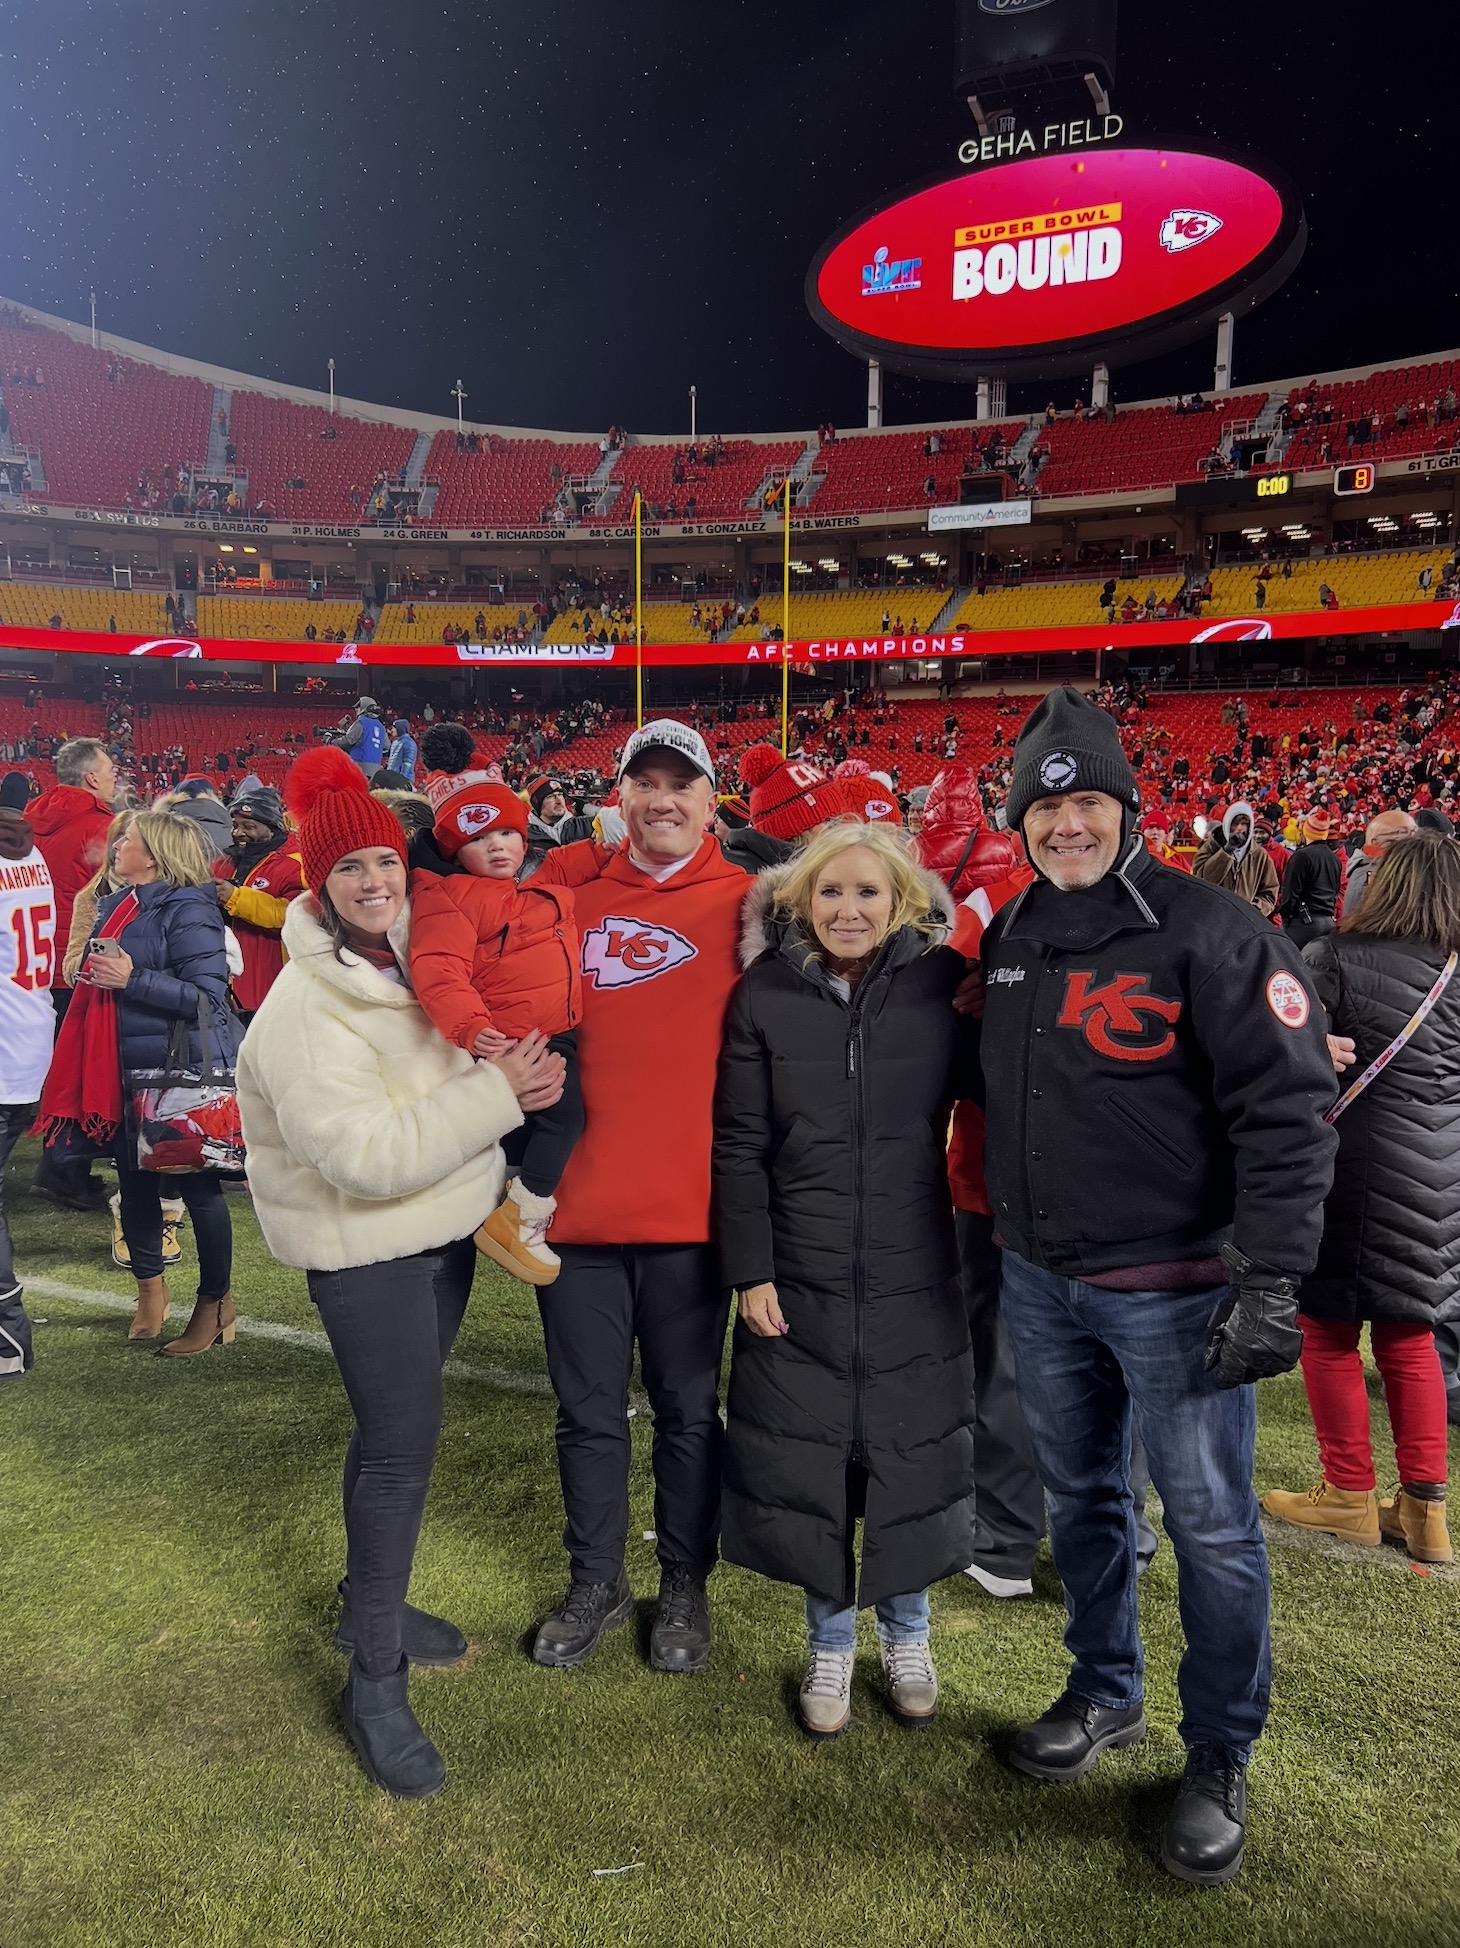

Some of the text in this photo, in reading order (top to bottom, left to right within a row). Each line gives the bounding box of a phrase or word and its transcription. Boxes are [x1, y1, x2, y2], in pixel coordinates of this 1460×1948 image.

[958, 114, 1124, 164] GEHA FIELD
[965, 209, 1110, 242] SUPER BOWL
[953, 226, 1123, 301] BOUND
[1408, 461, 1421, 471] 61
[1425, 458, 1437, 469] T.
[1257, 476, 1289, 497] 0:00
[1354, 468, 1368, 489] 8
[184, 521, 268, 534] 26 G. BARBARO
[292, 527, 361, 538] 31 P. HOLMES
[682, 522, 766, 535] 88 T. GONZALEZ
[788, 515, 860, 529] 54 B. WATERS
[383, 530, 448, 540] 24 G. GREEN
[470, 529, 566, 540] 49 T. RICHARDSON
[589, 529, 601, 538] 88
[603, 529, 614, 538] C.
[747, 636, 966, 660] AFC CHAMPIONS
[431, 776, 467, 802] CHIEFS
[465, 808, 490, 824] KC
[10, 902, 52, 992] 15
[604, 930, 669, 971] KC
[1057, 970, 1184, 1063] KC
